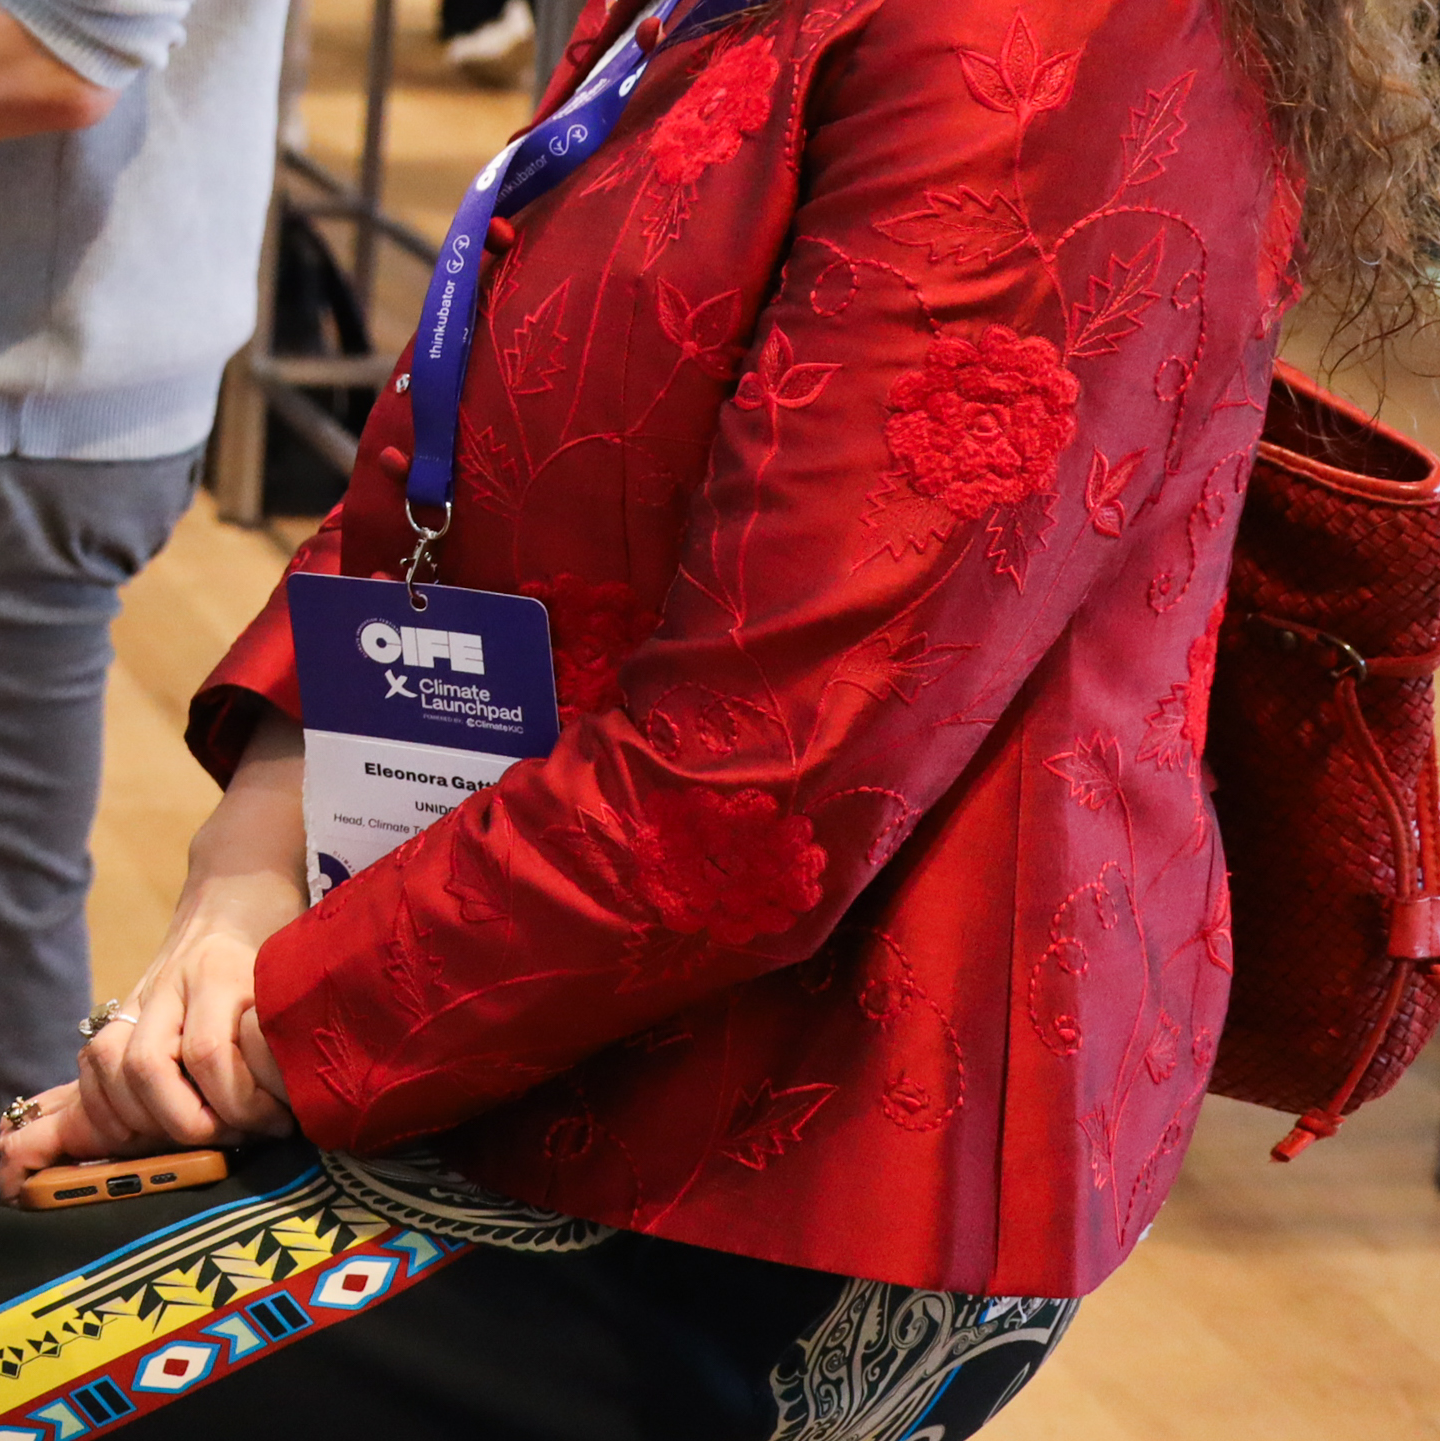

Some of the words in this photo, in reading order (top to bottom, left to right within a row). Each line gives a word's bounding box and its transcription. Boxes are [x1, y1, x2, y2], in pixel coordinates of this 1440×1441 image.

[429, 280, 456, 360] thinkubator
[419, 678, 491, 702] Climate
[421, 694, 523, 722] Launchpad
[364, 762, 448, 788] Eleonora
[333, 813, 366, 828] Head,
[368, 818, 410, 835] Climate
